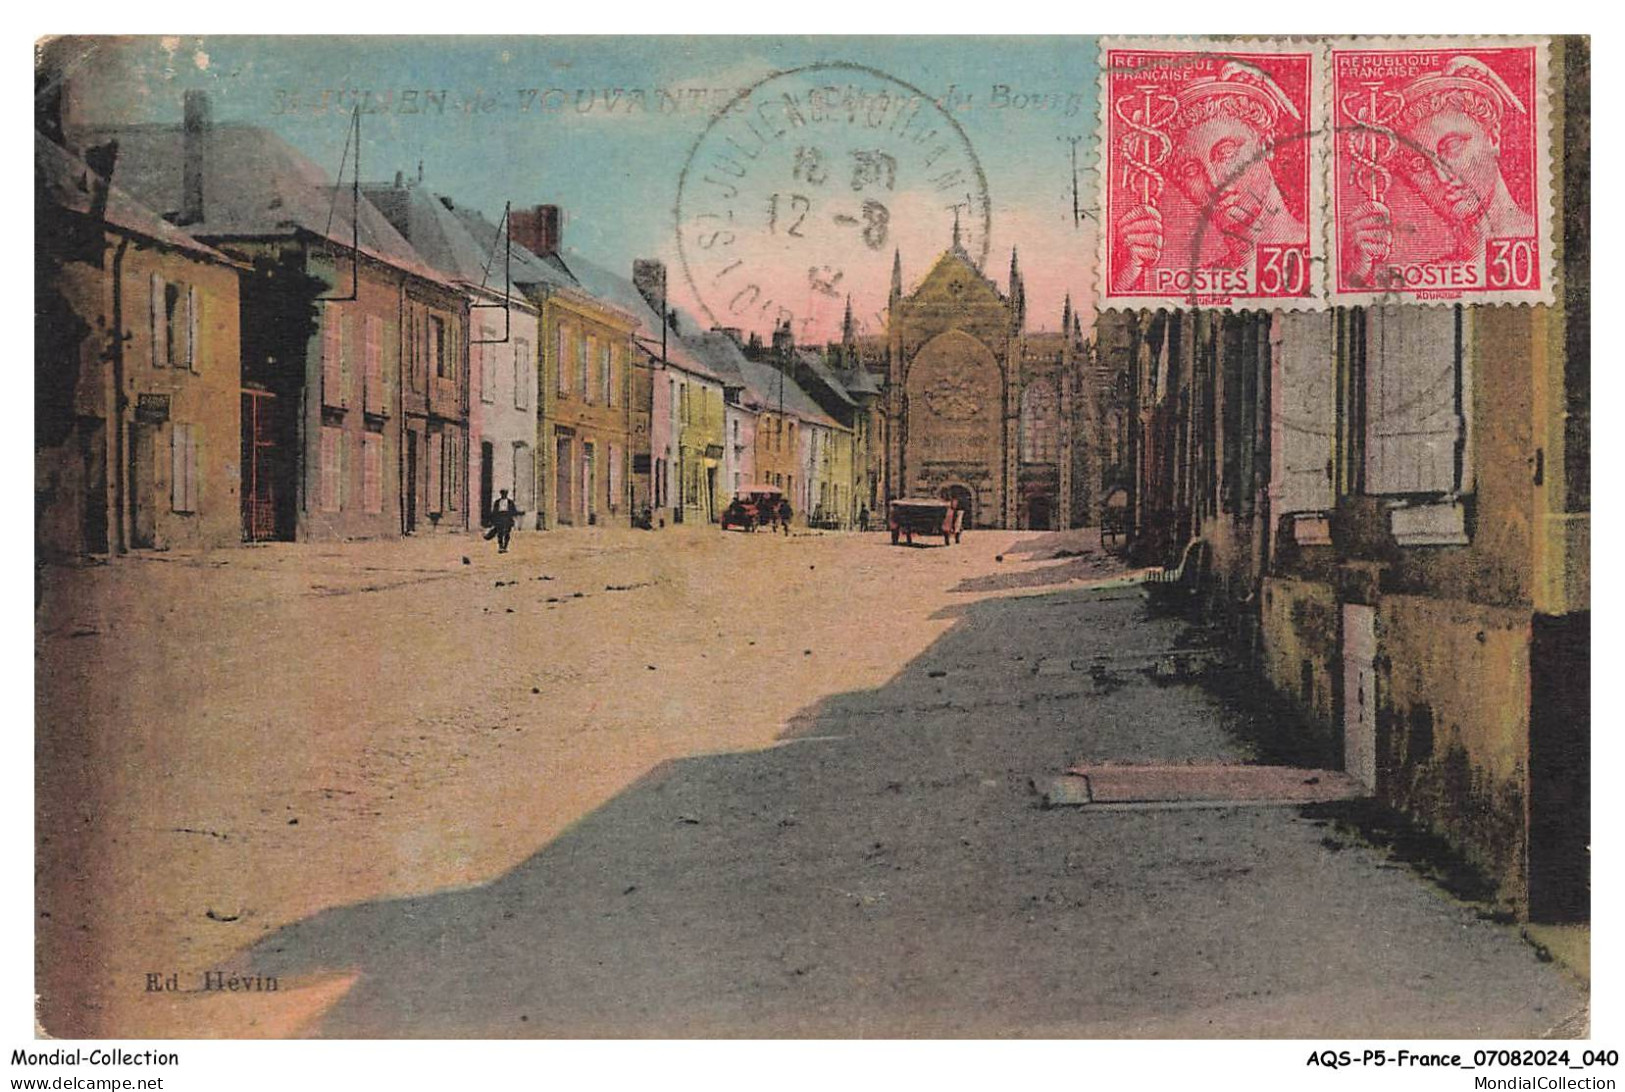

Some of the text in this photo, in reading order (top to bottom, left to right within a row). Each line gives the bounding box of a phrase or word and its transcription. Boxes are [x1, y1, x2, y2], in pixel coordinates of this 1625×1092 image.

[989, 84, 1083, 117] Bourg
[1158, 269, 1248, 291] POSTES
[1391, 263, 1478, 286] POSTES
[204, 971, 278, 992] Hévin
